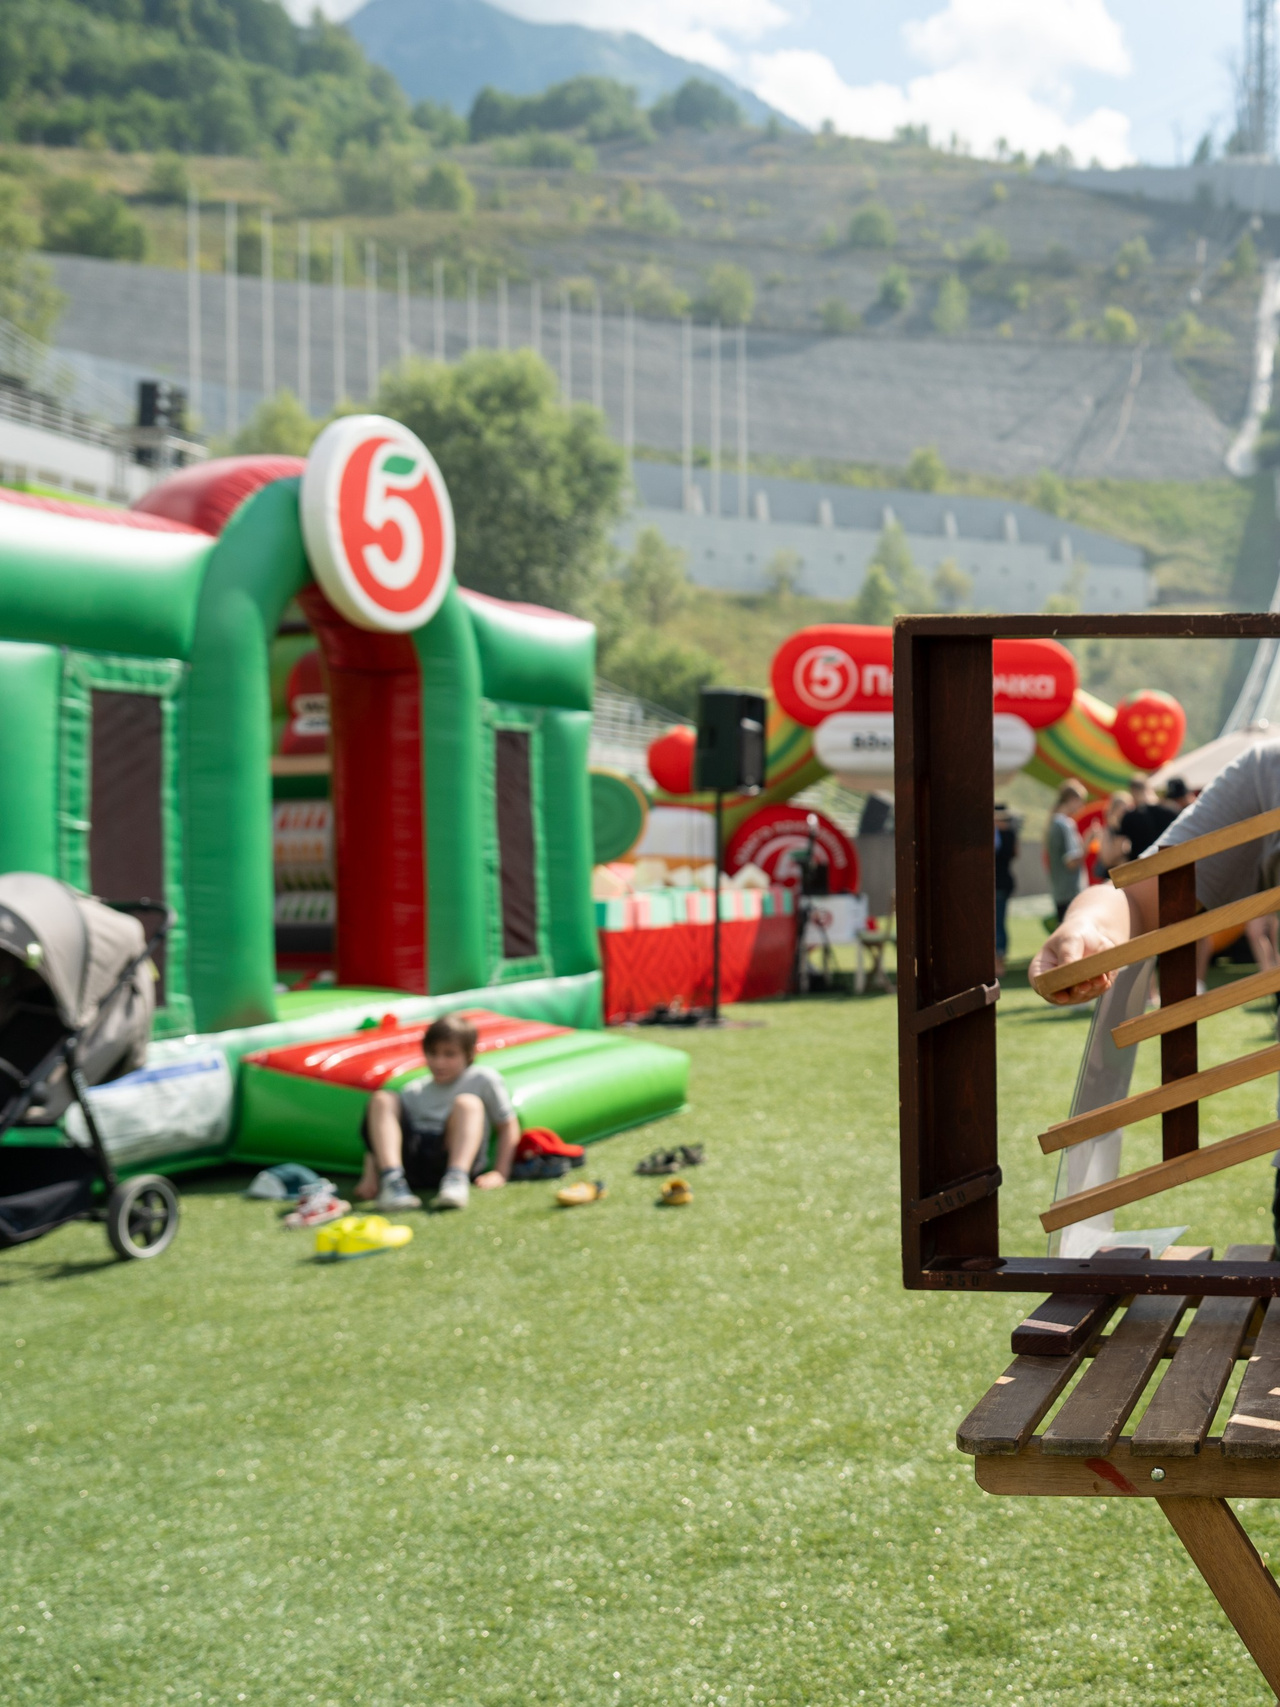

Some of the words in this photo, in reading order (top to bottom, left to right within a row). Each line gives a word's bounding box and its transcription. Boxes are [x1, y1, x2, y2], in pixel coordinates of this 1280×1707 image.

[362, 440, 430, 591] 5
[809, 653, 843, 699] 5
[934, 1189, 968, 1213] 100
[945, 1273, 980, 1288] 250
